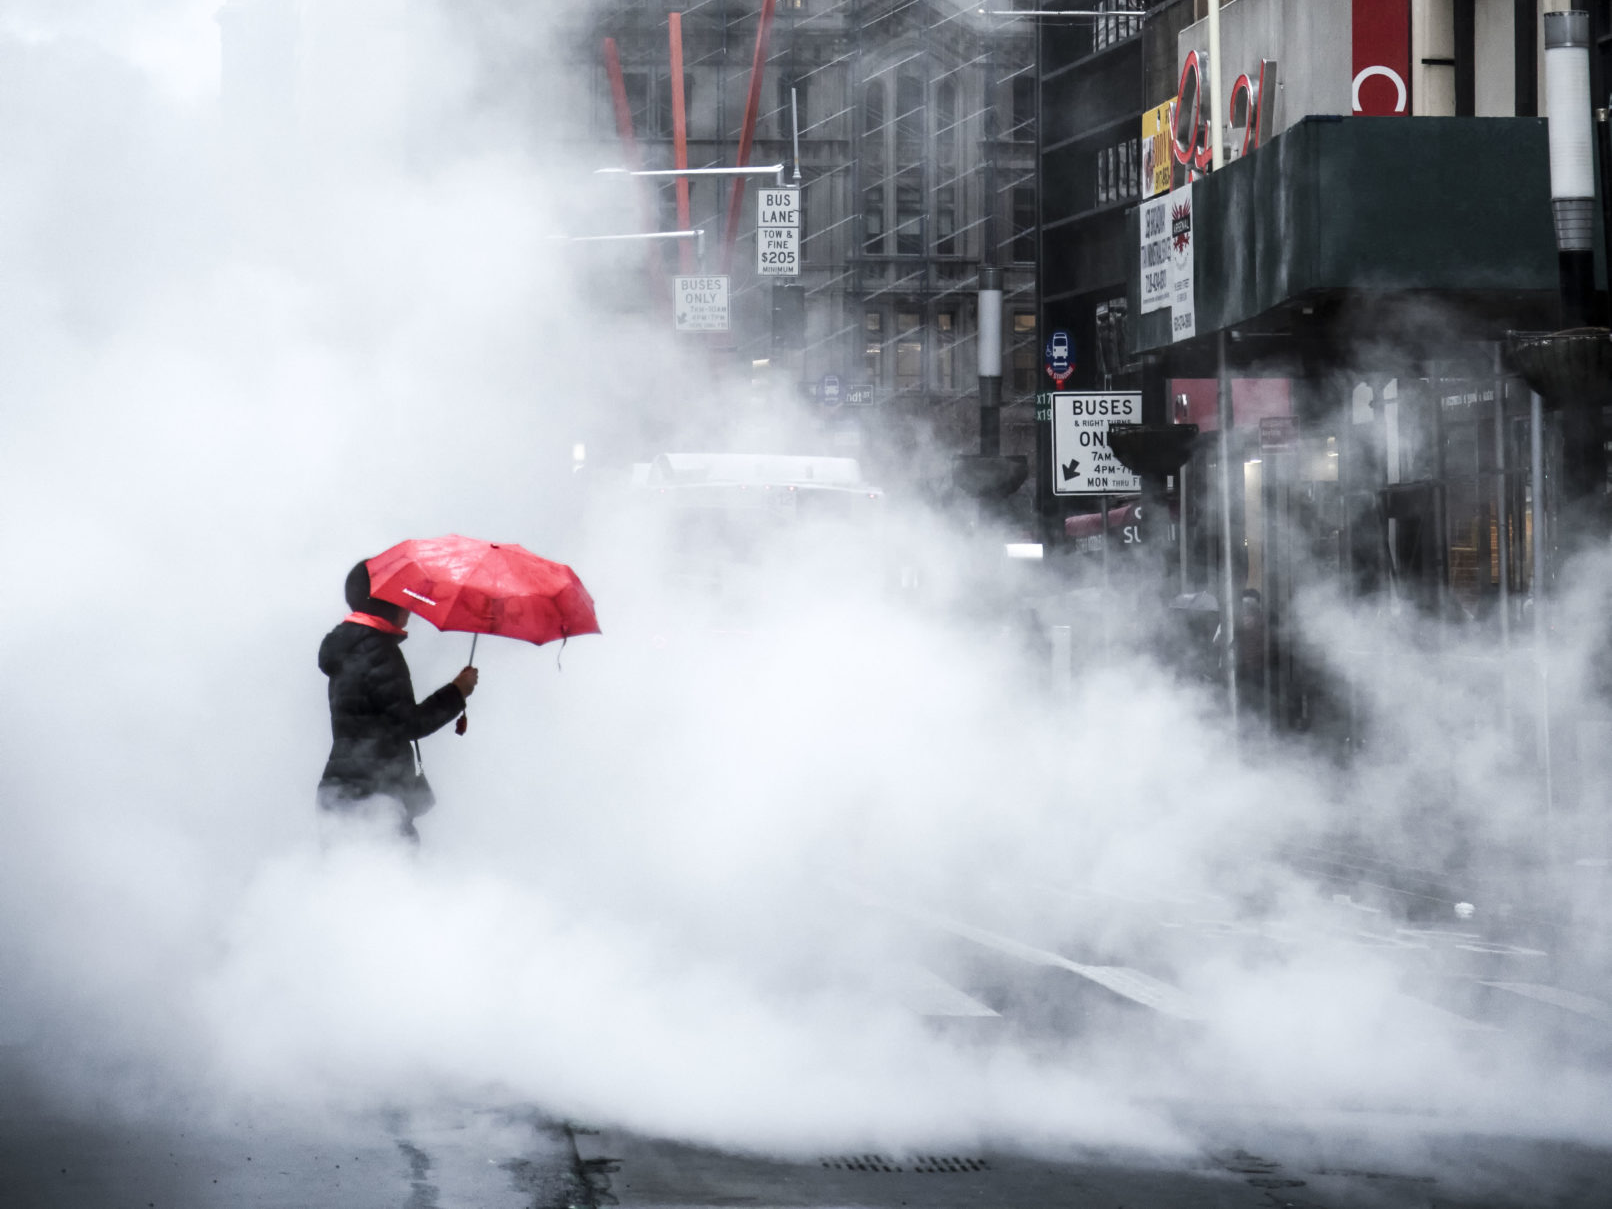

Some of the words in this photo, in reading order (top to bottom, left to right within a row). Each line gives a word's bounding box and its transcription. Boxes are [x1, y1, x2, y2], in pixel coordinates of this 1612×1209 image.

[766, 194, 791, 206] BUS
[763, 210, 795, 223] LANE
[763, 230, 783, 239] TOW
[786, 230, 793, 239] &
[767, 240, 789, 249] FINE
[761, 251, 795, 264] $205
[681, 279, 721, 291] BUSES
[685, 293, 717, 304] ONLY
[1073, 399, 1133, 416] BUSES
[1082, 419, 1104, 427] RIGHT
[1087, 477, 1108, 487] MON
[1112, 479, 1129, 487] THRU
